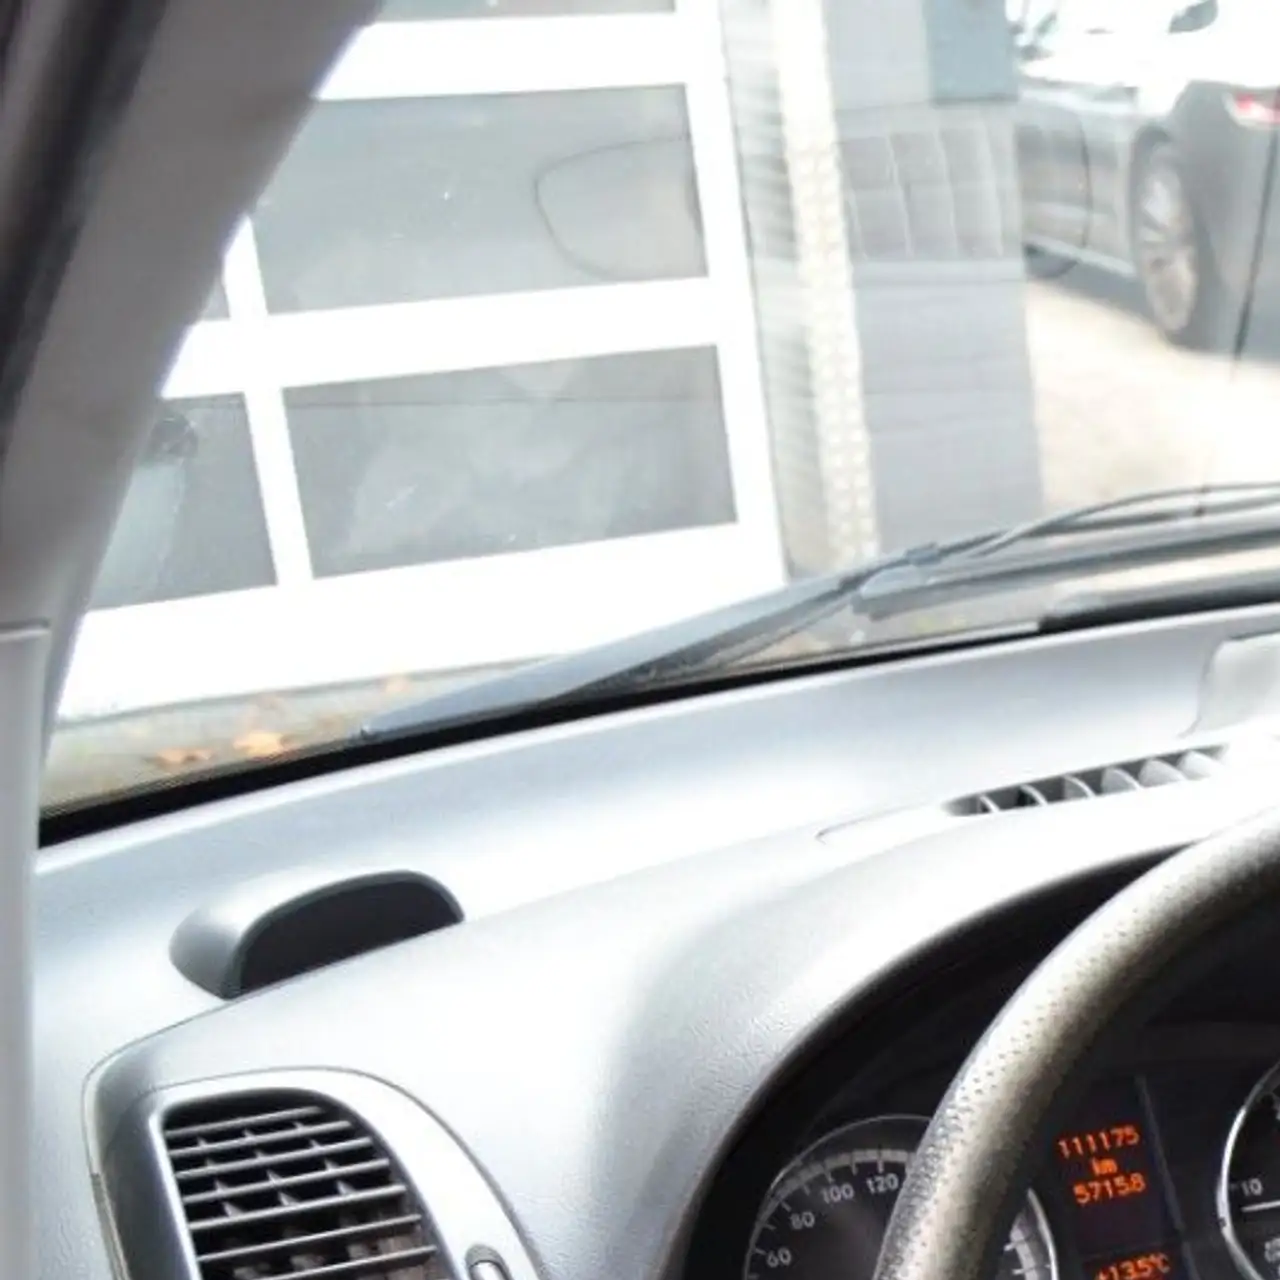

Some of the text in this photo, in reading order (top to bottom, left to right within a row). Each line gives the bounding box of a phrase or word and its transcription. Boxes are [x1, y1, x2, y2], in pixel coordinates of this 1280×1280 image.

[1058, 1124, 1140, 1159] 111175
[1091, 1156, 1118, 1176] km
[866, 1173, 899, 1194] 120
[1241, 1177, 1263, 1197] 10
[821, 1184, 855, 1205] 100
[790, 1211, 816, 1231] 80
[766, 1247, 792, 1268] 60
